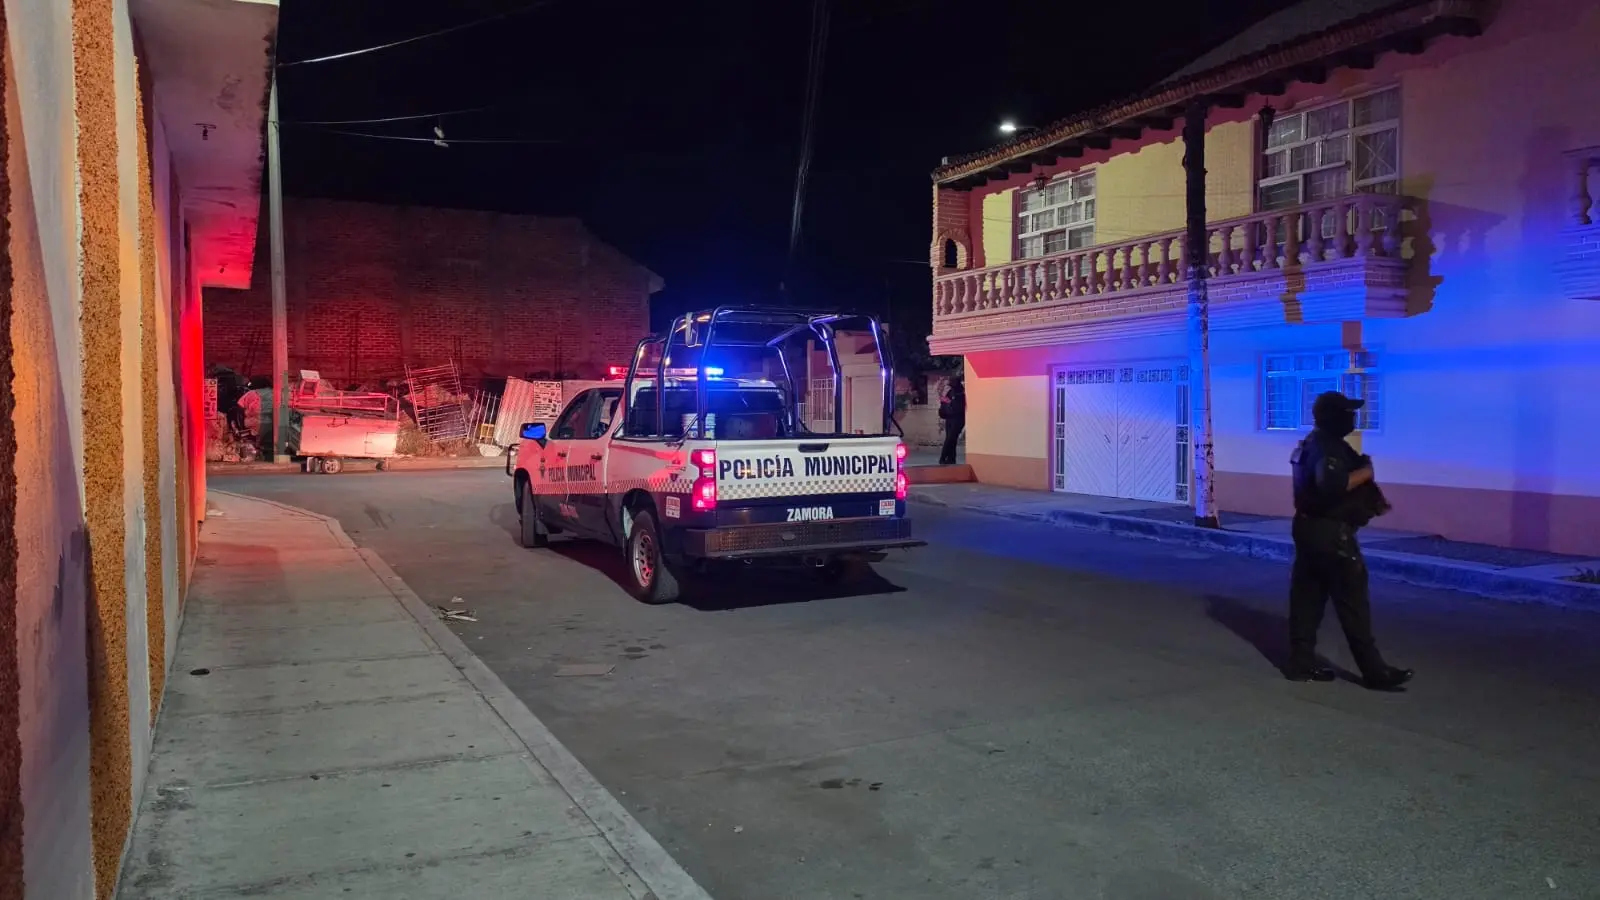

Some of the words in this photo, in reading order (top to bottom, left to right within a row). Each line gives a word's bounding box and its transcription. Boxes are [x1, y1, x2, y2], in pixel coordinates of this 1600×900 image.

[567, 464, 596, 481] MUNICIPAL
[719, 455, 794, 480] POLICÍA
[804, 454, 895, 477] MUNICIPAL
[786, 506, 834, 522] ZAMORA
